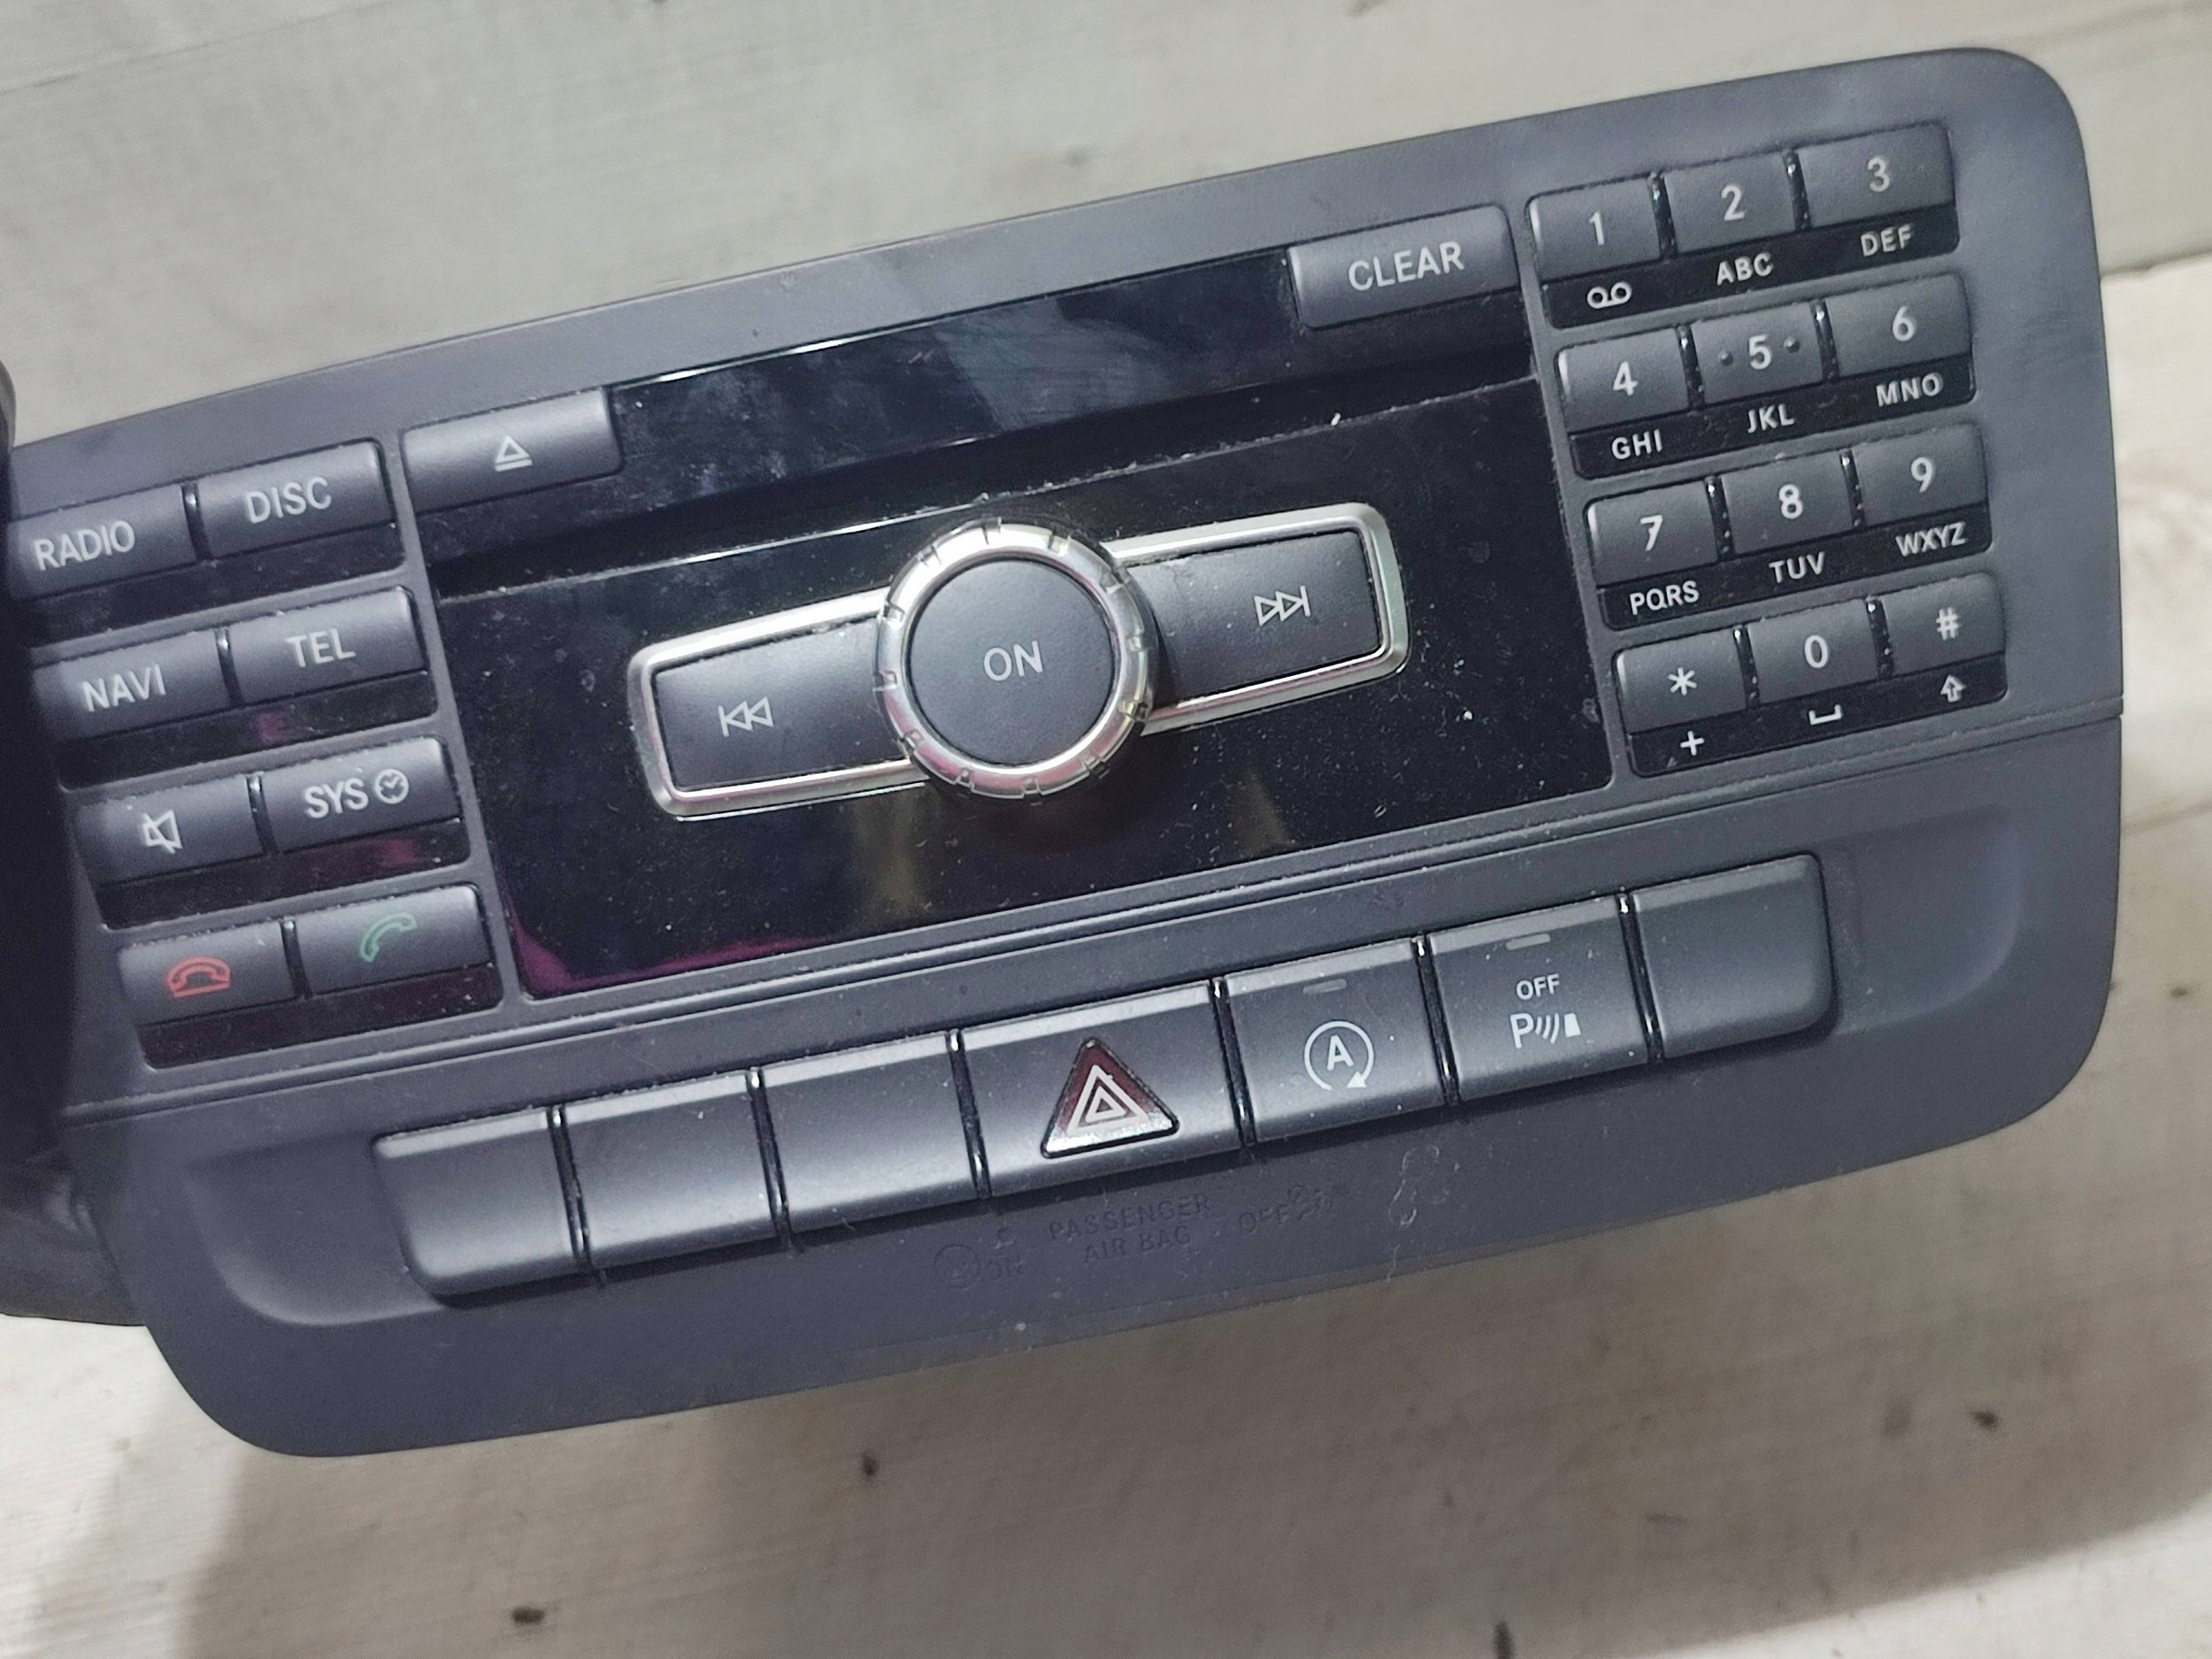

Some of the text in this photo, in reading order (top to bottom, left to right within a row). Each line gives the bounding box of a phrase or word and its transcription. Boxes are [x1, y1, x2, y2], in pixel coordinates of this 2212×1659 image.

[1867, 156, 1891, 192] 3
[1721, 185, 1745, 220] 2
[1588, 211, 1605, 245] 1
[1861, 224, 1915, 257] DEF
[1348, 242, 1464, 291] CLEAR
[1716, 252, 1774, 286] ABC
[1892, 306, 1916, 342] 6
[1748, 334, 1771, 370] 5
[1612, 361, 1638, 396] 4
[1876, 373, 1943, 407] MNO
[1747, 404, 1795, 434] JKL
[1611, 429, 1663, 460] GHI
[1910, 457, 1933, 493] 9
[245, 476, 333, 524] DISC
[1778, 484, 1803, 519] 8
[34, 520, 135, 571] RADIO
[1640, 514, 1663, 551] 7
[1895, 521, 1967, 557] WXYZ
[1770, 551, 1827, 584] TUV
[1629, 580, 1700, 616] PQRS
[1936, 607, 1960, 641] #
[286, 628, 356, 668] TEL
[983, 641, 1044, 681] ON
[1804, 634, 1829, 669] 0
[82, 664, 166, 712] NAVI
[304, 778, 370, 818] SYS
[1516, 973, 1561, 1001] OFF
[1326, 1034, 1355, 1071] A
[1049, 1194, 1213, 1240] PASSENGER
[1239, 1202, 1289, 1234] OFF
[1084, 1224, 1191, 1263] AIR BAG
